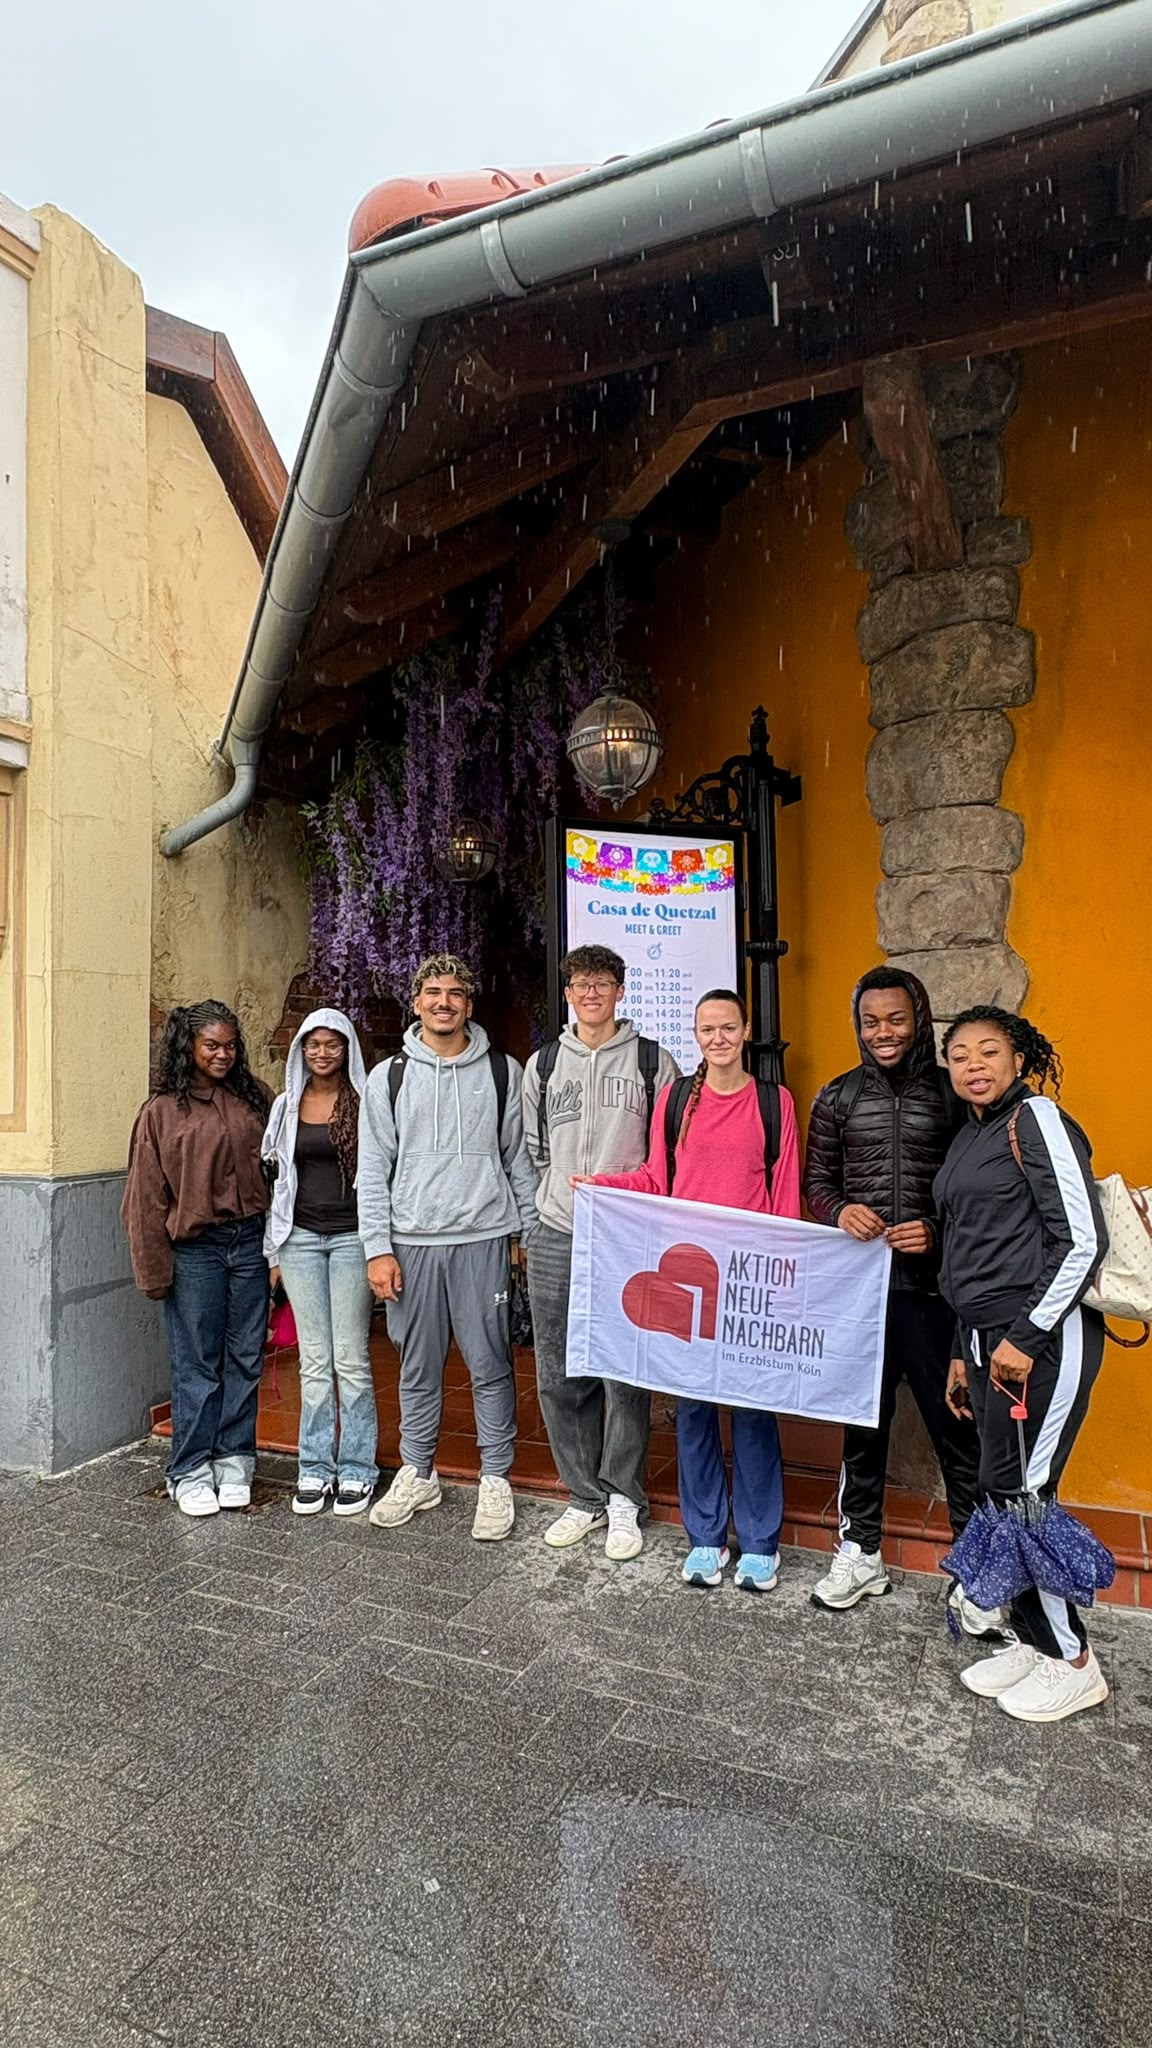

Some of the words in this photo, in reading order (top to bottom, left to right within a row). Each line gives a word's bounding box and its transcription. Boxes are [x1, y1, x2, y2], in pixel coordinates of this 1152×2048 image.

[587, 900, 627, 916] Casa
[631, 902, 651, 917] de
[655, 904, 717, 921] Quetzal
[625, 924, 647, 934] MEET
[649, 925, 655, 935] &
[657, 925, 681, 935] GREET
[654, 968, 681, 978] 11:20
[655, 982, 681, 991] 12:20
[622, 995, 643, 1004] 3:00
[655, 995, 681, 1005] 13:20
[656, 1009, 681, 1018] 14:20
[656, 1023, 681, 1032] 15:50
[727, 1250, 796, 1288] AKTION
[725, 1282, 777, 1318] NEUE
[722, 1314, 825, 1359] NACHBARN
[721, 1349, 735, 1361] im
[738, 1352, 794, 1372] Erzbistum
[798, 1362, 821, 1377] Köln
